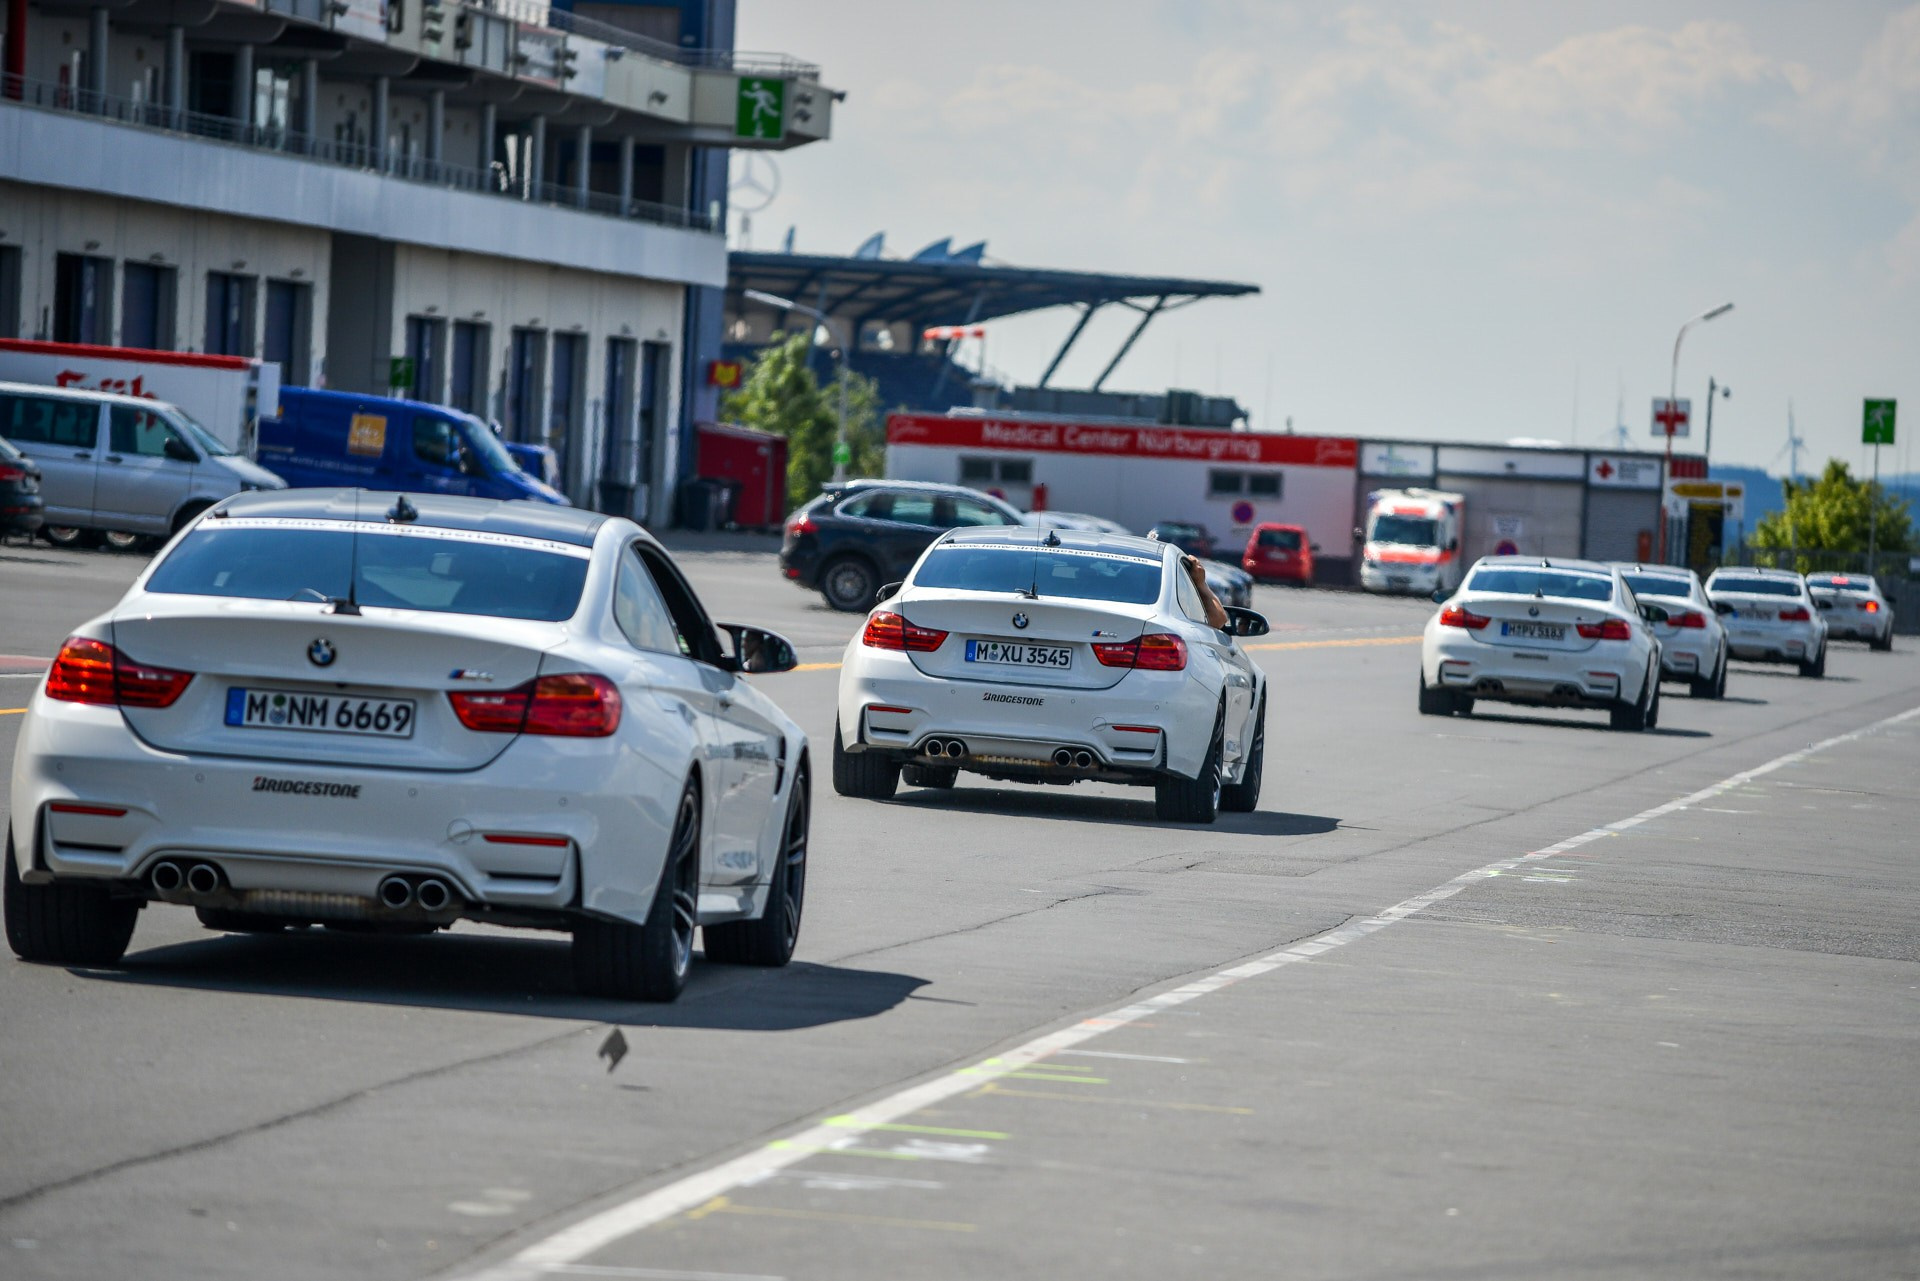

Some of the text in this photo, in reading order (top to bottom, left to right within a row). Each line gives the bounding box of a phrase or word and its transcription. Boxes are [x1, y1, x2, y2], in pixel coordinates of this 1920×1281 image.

[982, 420, 1260, 459] Medical Center Nürburgring
[976, 643, 1070, 666] M XU 3545
[982, 692, 1044, 706] BRIDGESTONE
[246, 694, 411, 732] M NM 6669
[252, 776, 361, 798] BRIDGESTONE
